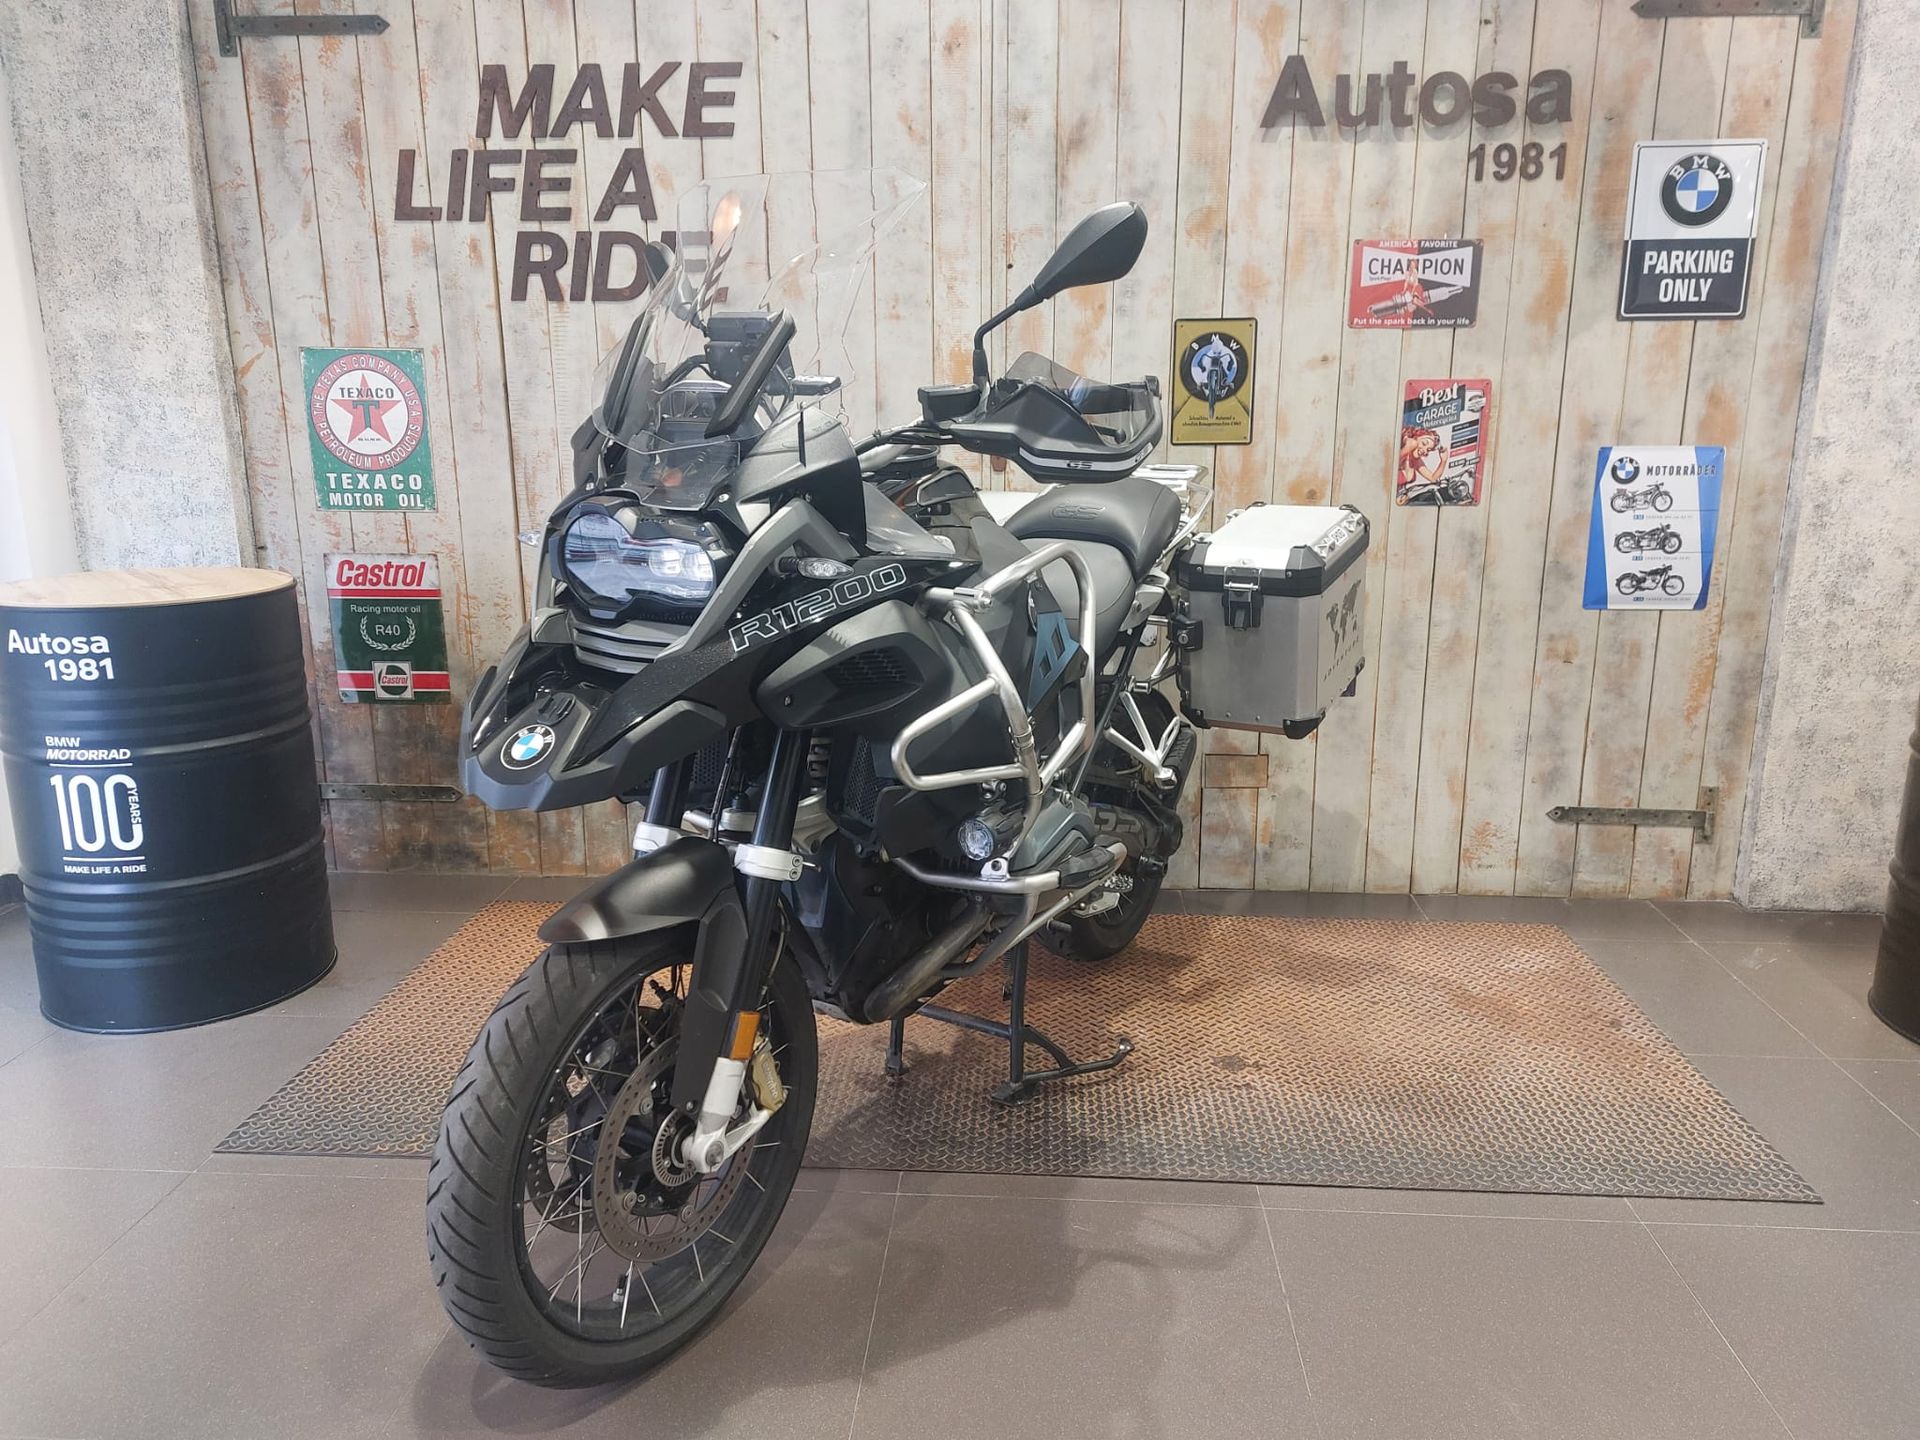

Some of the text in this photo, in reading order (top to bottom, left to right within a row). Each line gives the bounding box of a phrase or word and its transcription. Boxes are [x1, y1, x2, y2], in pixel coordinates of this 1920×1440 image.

[475, 62, 743, 139] MAKE
[1260, 54, 1572, 128] Autosa
[1467, 142, 1568, 182] 1981
[1669, 156, 1731, 181] BMW
[394, 148, 658, 222] LIFE A
[1420, 240, 1458, 248] FAVORITE
[511, 230, 729, 302] RIDE
[1643, 249, 1735, 275] PARKING
[1658, 278, 1713, 303] ONLY
[1384, 318, 1405, 327] spark
[1437, 319, 1456, 327] your
[317, 360, 347, 390] TEXAS
[352, 356, 408, 385] COMPANY
[313, 394, 324, 415] THE
[339, 387, 395, 399] TEXACO
[1419, 382, 1459, 408] Best
[352, 400, 380, 429] T
[1416, 402, 1459, 423] GARAGE
[319, 421, 421, 468] PETROLEUM PRODUCTS
[1066, 459, 1093, 470] GS
[1646, 464, 1717, 476] MOTORRÄDER
[326, 472, 423, 490] TEXACO
[329, 492, 425, 507] MOTOR OIL
[336, 559, 426, 587] Castrol
[350, 604, 421, 614] Racing motor oil
[728, 563, 907, 652] R1200
[8, 629, 111, 655] Autosa
[375, 624, 401, 636] R40
[44, 657, 115, 682] 1981
[381, 675, 409, 685] Castrol
[45, 735, 80, 748] BMW
[46, 748, 132, 761] MOTORRAD
[50, 774, 144, 852] 100
[127, 787, 142, 825] YEARS
[64, 864, 147, 874] MAKE LIFE A RIDE
